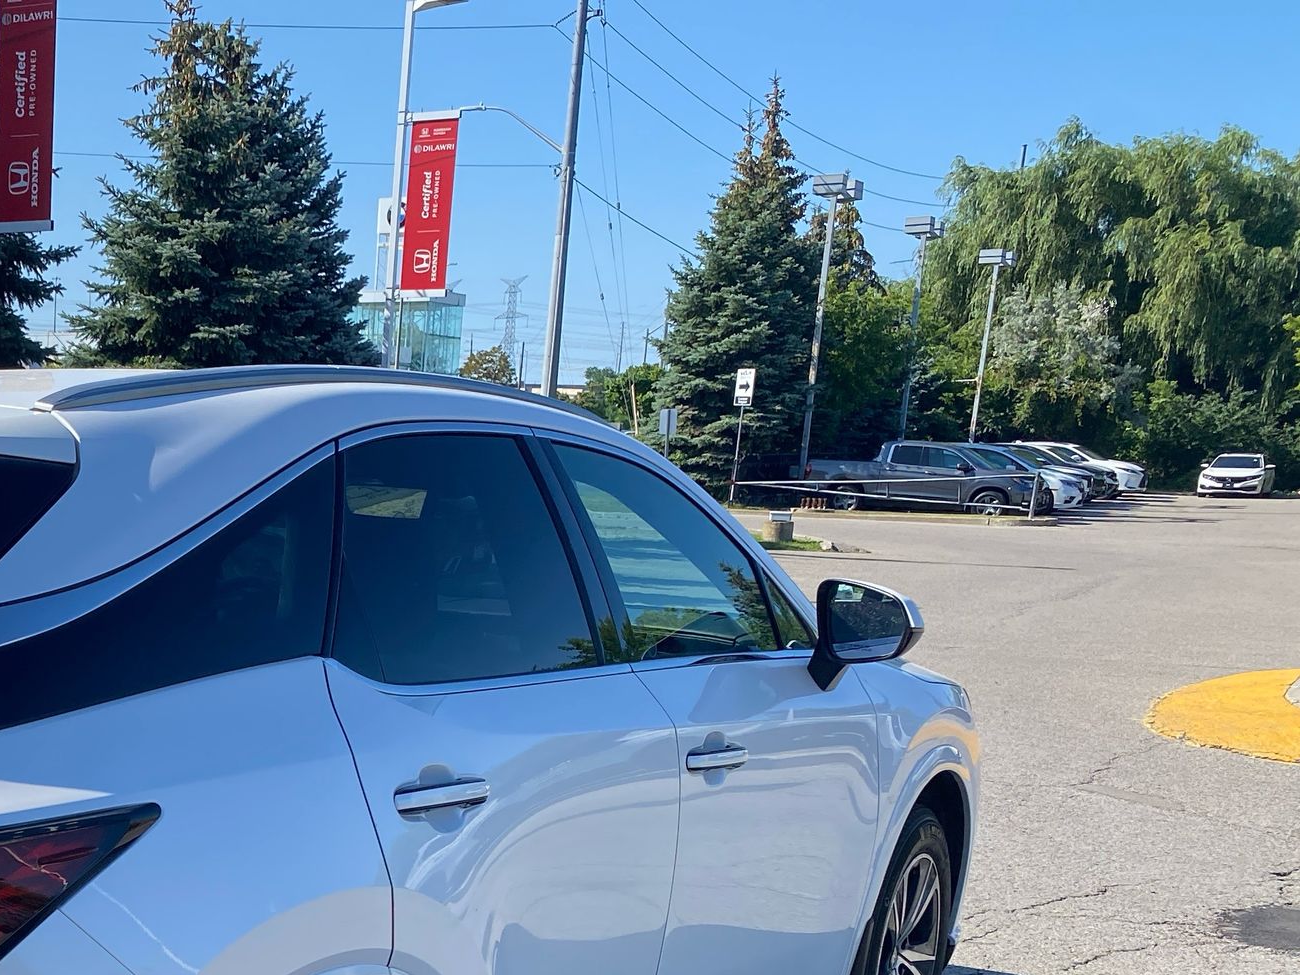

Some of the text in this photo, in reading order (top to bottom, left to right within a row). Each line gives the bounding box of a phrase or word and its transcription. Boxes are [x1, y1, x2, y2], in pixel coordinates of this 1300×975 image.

[13, 11, 53, 23] DILAWRI
[15, 51, 27, 118] Certified
[29, 49, 37, 117] PRE-OWNED
[422, 143, 455, 152] DILAWRI
[31, 147, 40, 208] HONDA
[421, 171, 432, 219] Certified
[431, 170, 441, 218] PRE-OWNED
[431, 239, 440, 282] HONDA
